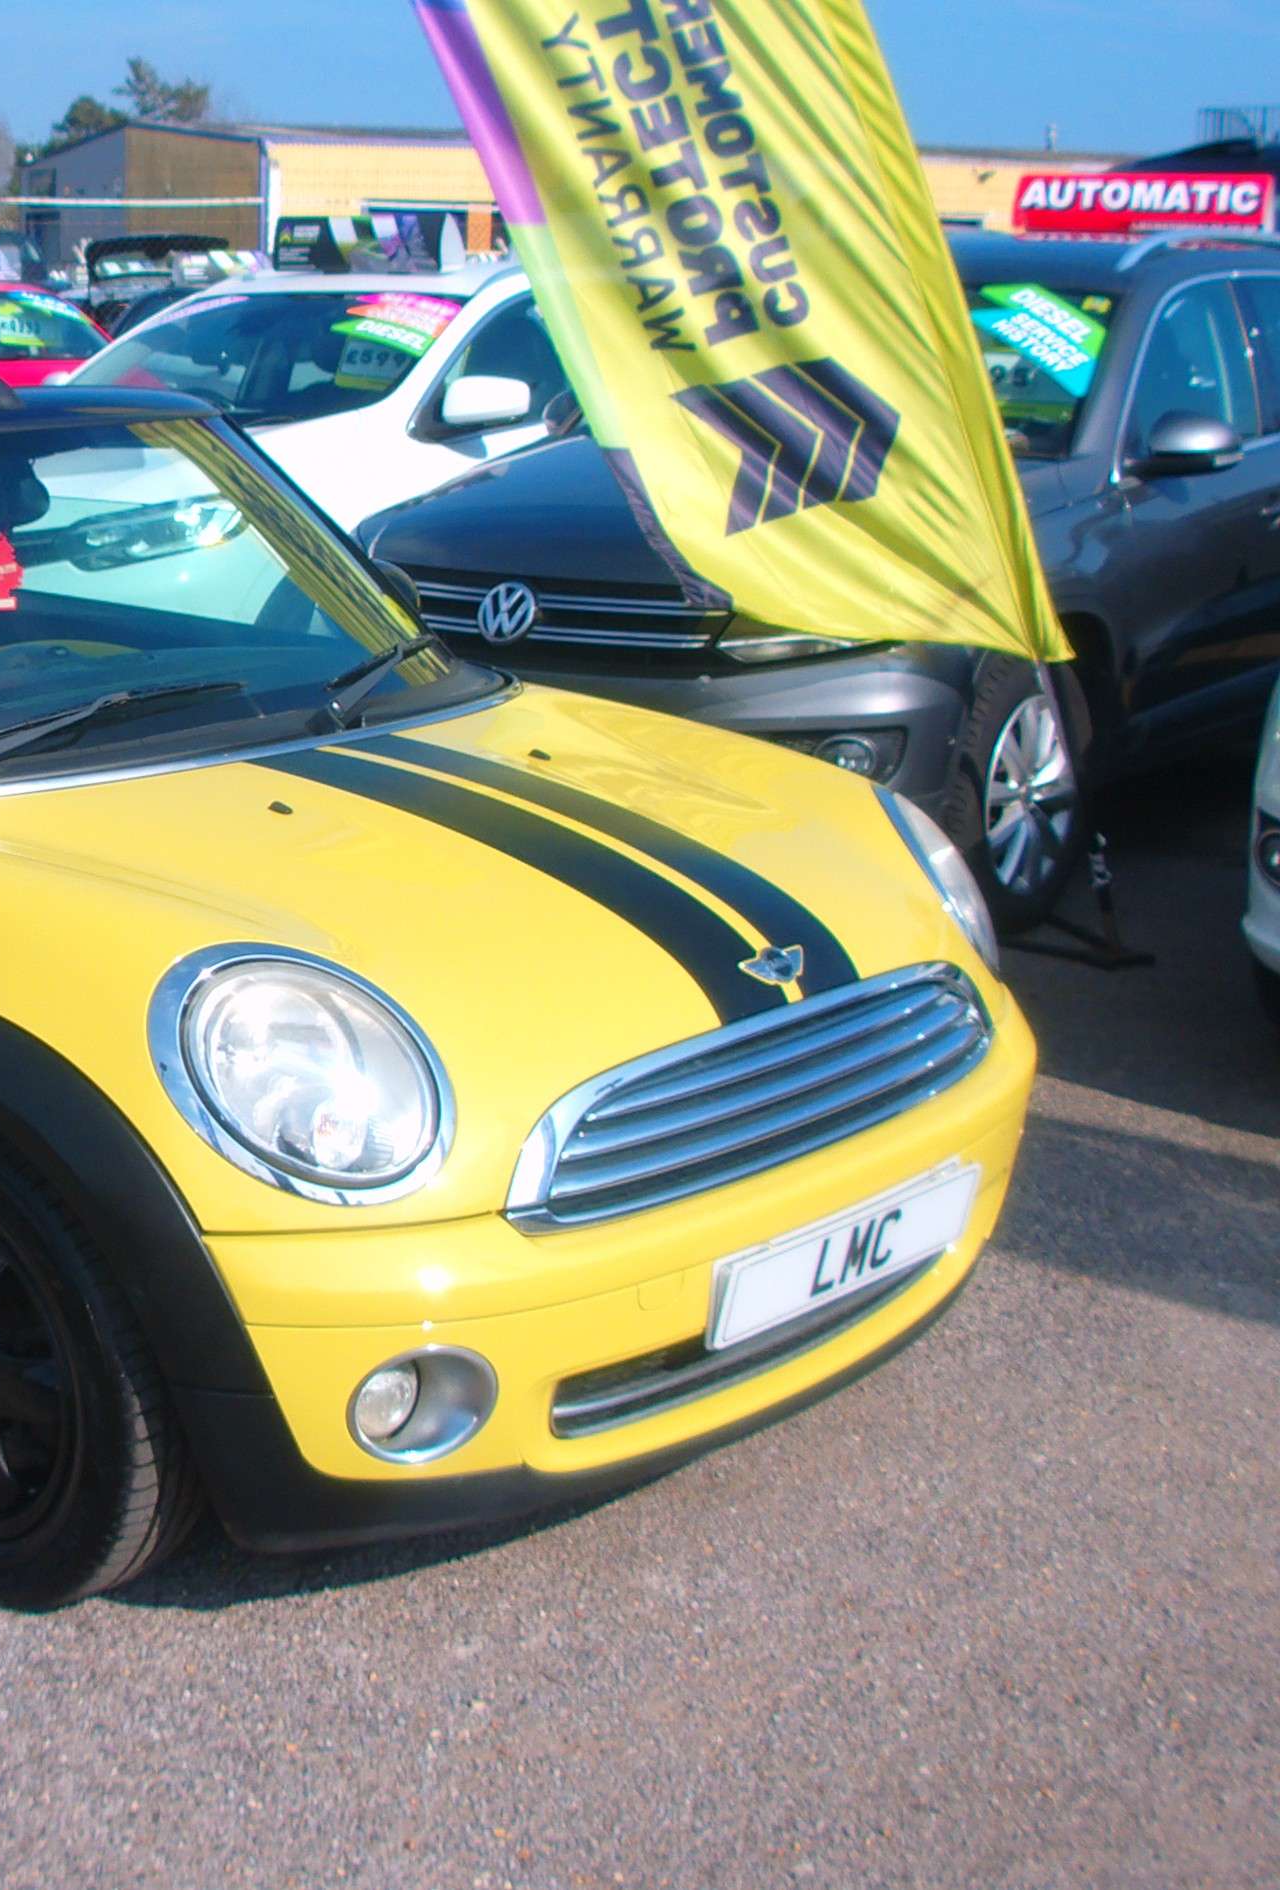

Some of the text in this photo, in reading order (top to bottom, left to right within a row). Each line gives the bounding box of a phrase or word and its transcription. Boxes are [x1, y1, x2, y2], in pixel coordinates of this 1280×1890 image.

[1020, 178, 1263, 215] AUTOMATIC
[355, 319, 426, 351] DIESEL
[1009, 312, 1090, 366] SERVICE
[1010, 287, 1092, 344] DIESEL
[991, 318, 1075, 373] HISTORY
[810, 1208, 903, 1298] LMC
